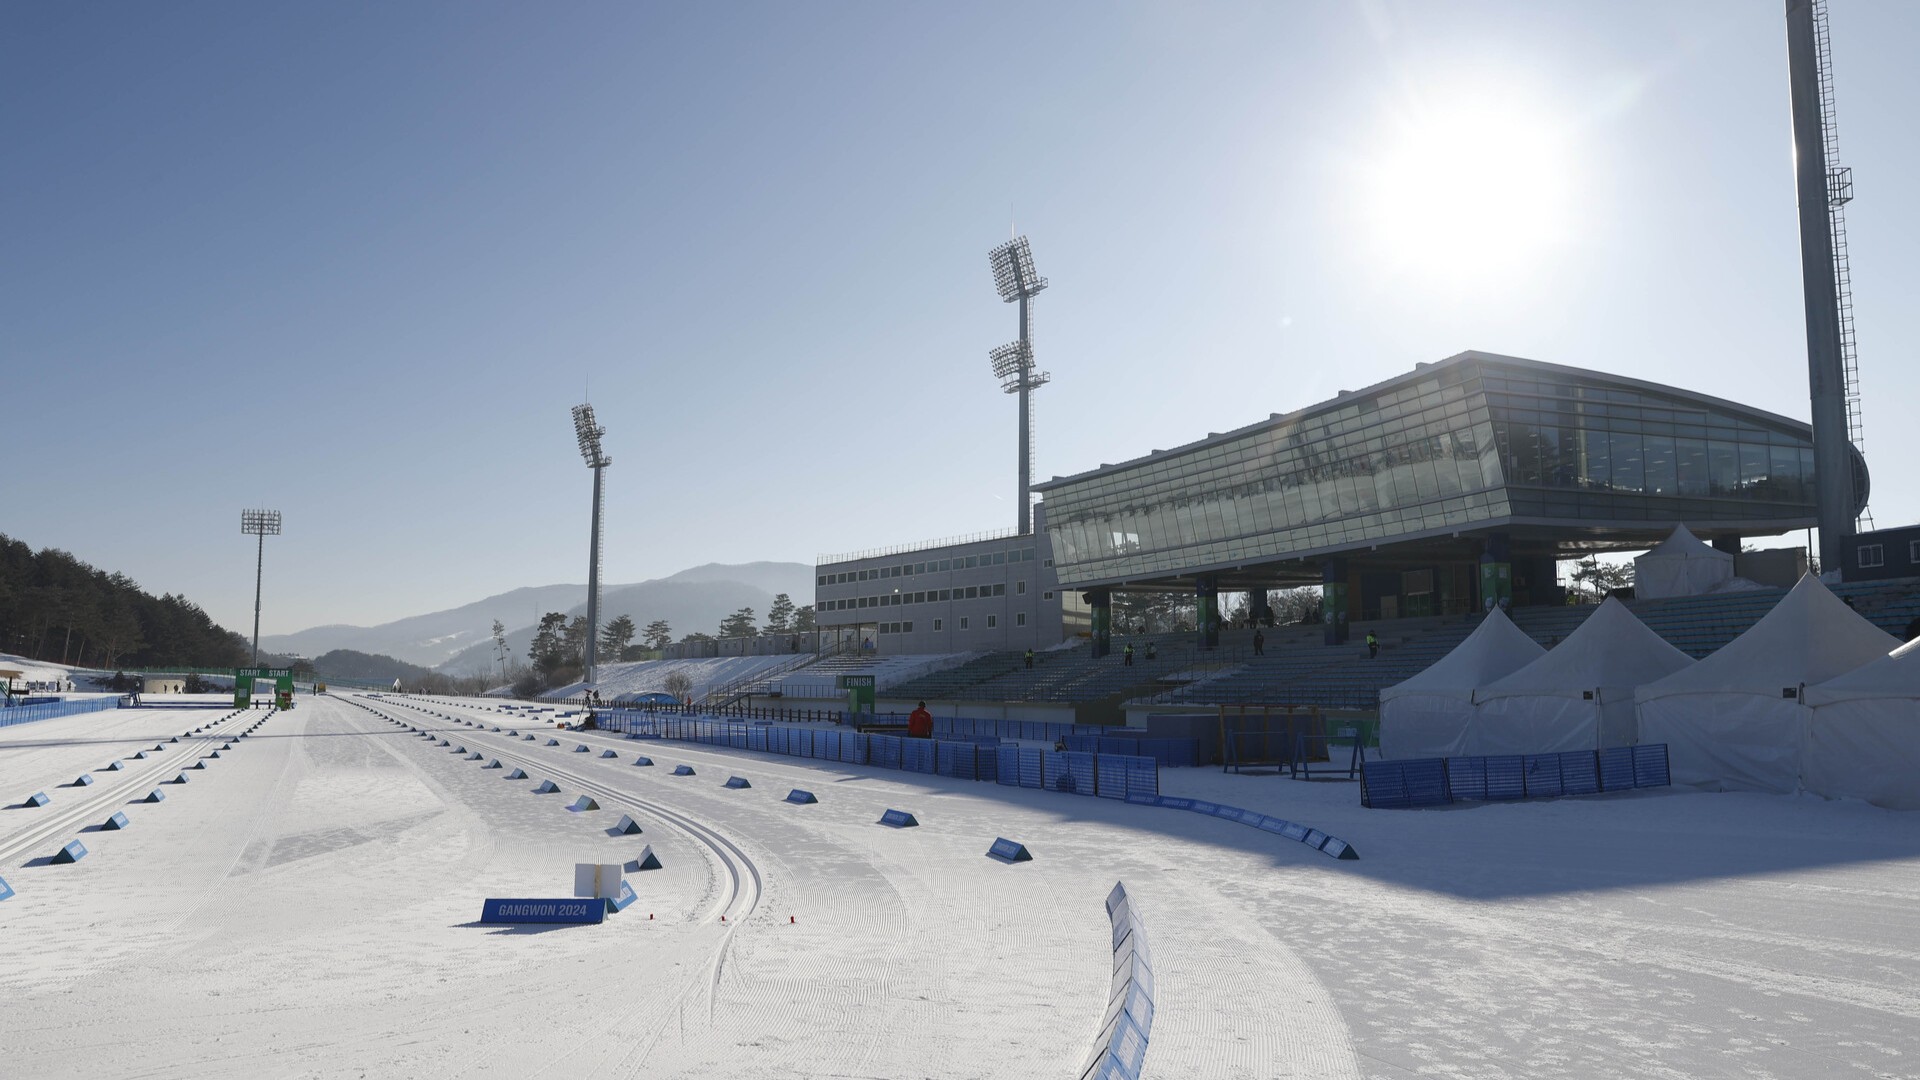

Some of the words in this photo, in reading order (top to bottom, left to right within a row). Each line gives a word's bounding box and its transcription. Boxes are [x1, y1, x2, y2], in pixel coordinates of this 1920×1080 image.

[240, 669, 261, 677] START
[846, 677, 872, 687] FINISH
[498, 904, 555, 916] GANGWON
[558, 904, 587, 916] 2024
